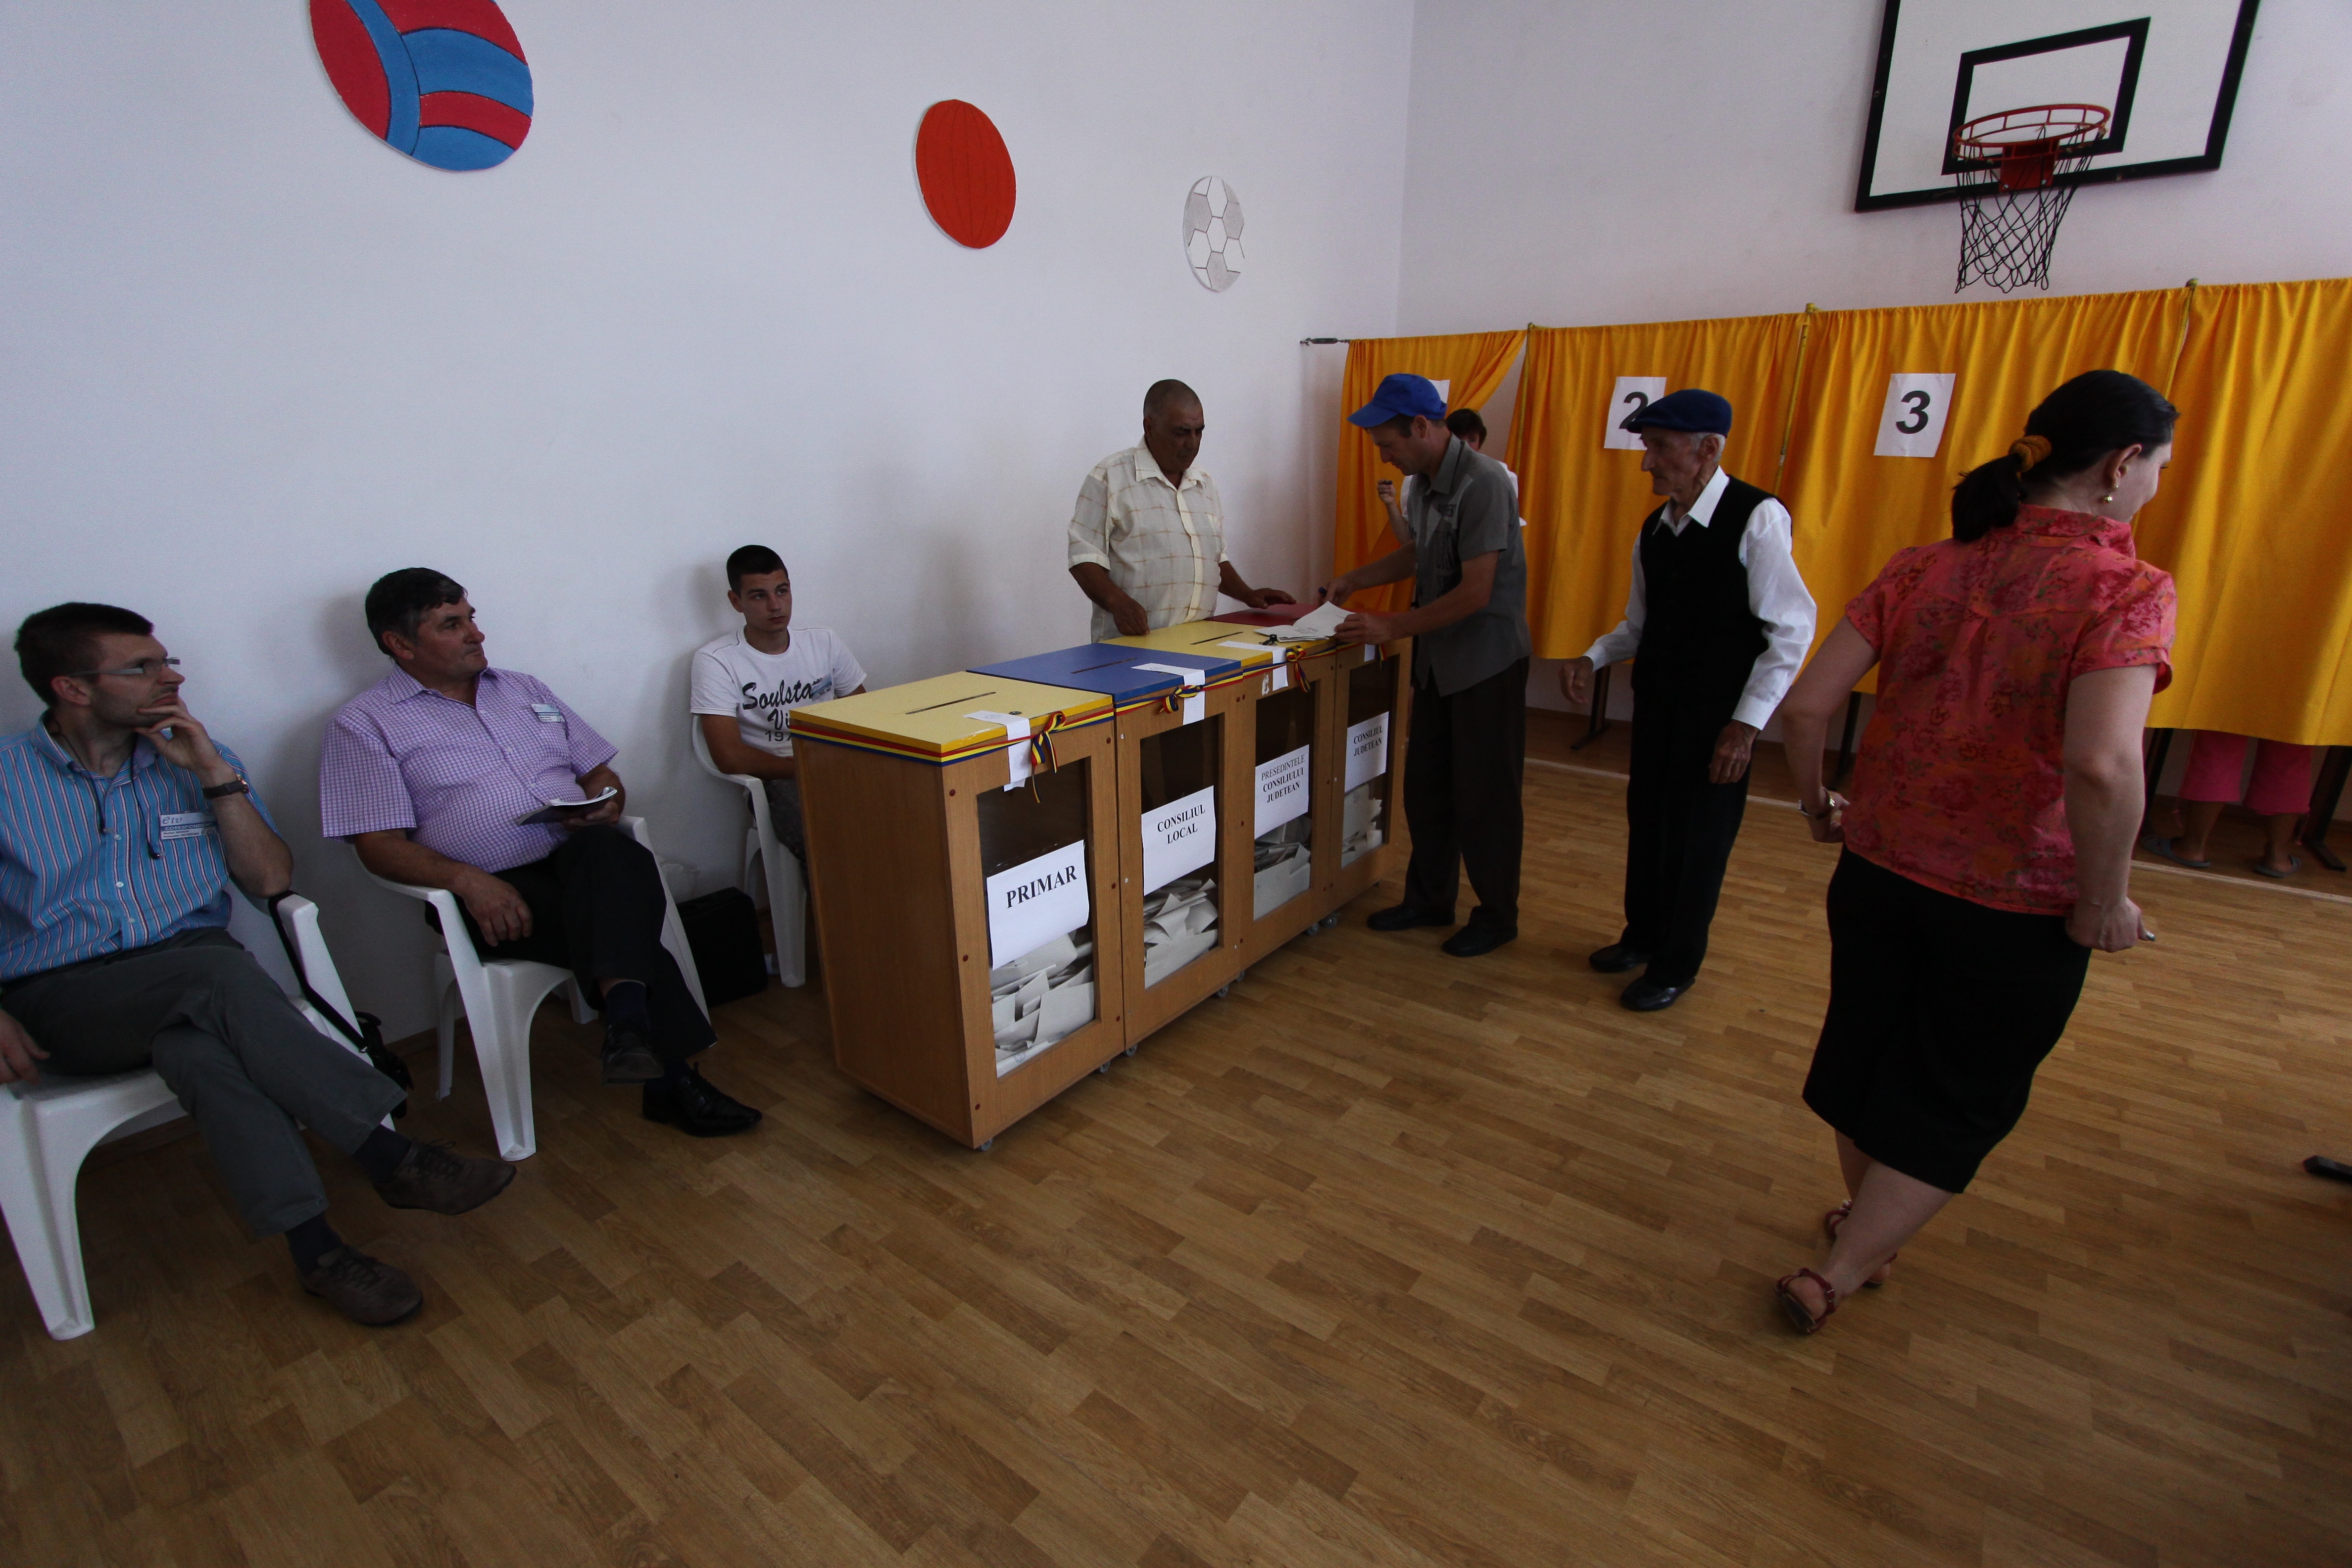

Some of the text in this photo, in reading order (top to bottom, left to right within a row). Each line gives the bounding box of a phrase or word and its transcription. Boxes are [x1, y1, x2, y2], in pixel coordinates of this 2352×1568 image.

[1619, 391, 1649, 429] 2
[1895, 391, 1931, 434] 3
[742, 679, 823, 710] Soulsta
[1354, 725, 1383, 744] CONSILIUL
[1354, 737, 1382, 757] JUDETEAN
[1262, 755, 1305, 781] PRESEDINTELE
[1263, 768, 1304, 792] CONSILIULUI
[1267, 781, 1301, 803] JUDETEAN
[1157, 804, 1206, 832] CONSILIUL
[1167, 823, 1198, 844] LOCAL
[1006, 865, 1078, 909] PRIMAR
